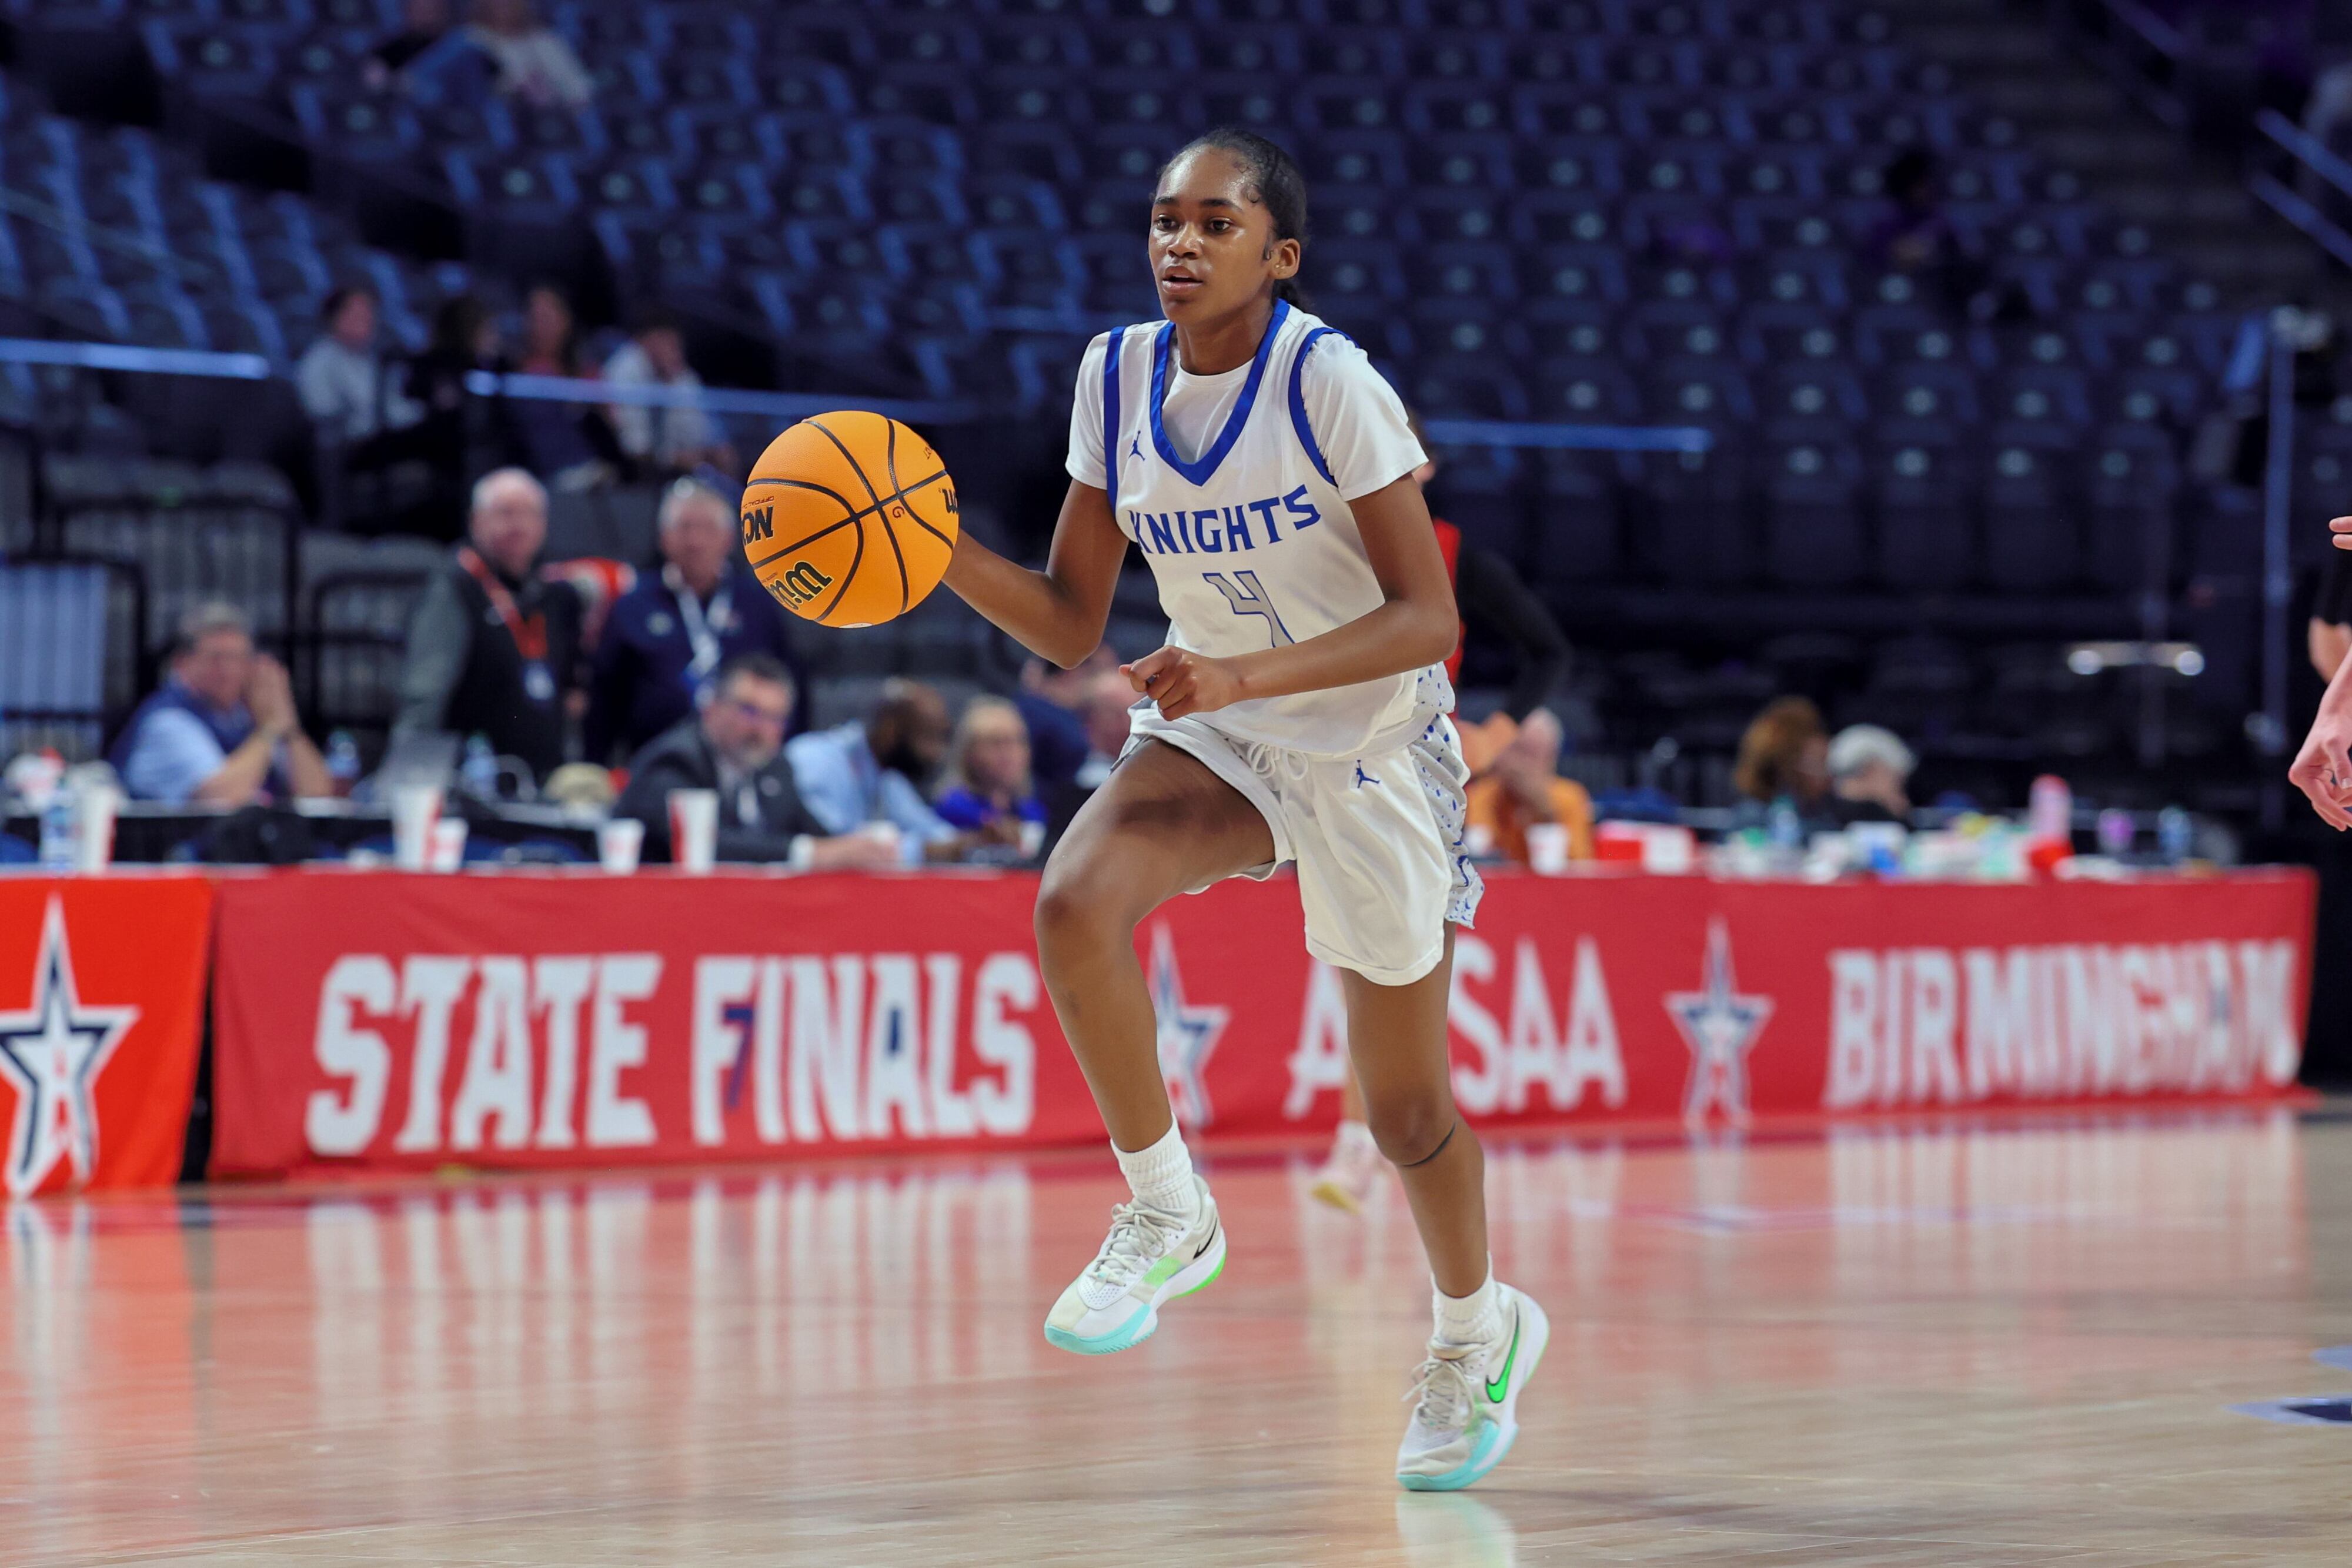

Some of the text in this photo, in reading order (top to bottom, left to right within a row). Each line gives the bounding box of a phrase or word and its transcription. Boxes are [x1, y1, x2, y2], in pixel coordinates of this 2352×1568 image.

[1128, 484, 1321, 554] KNIGHTS
[1202, 570, 1295, 648] 4
[305, 951, 1040, 1156] STATE FINALS
[1284, 932, 1629, 1121] ASAA
